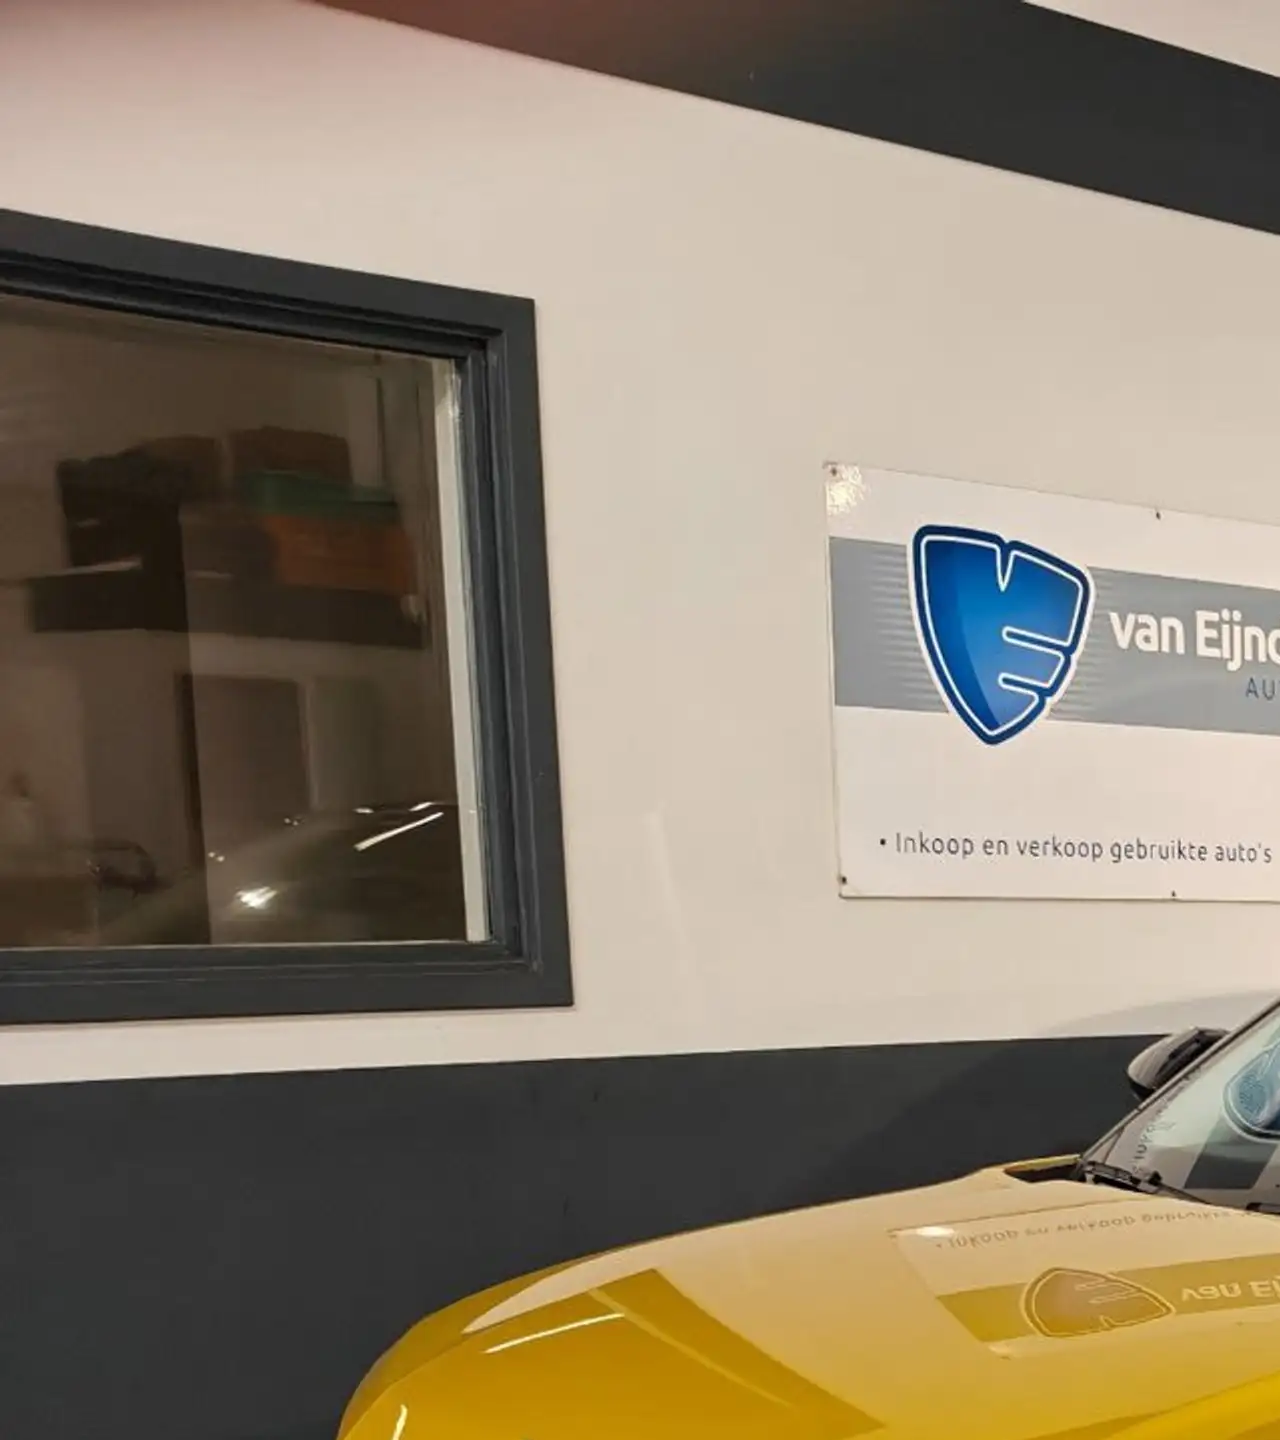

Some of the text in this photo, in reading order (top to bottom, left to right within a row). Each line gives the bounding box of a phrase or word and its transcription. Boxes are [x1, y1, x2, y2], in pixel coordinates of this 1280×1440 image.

[1108, 611, 1186, 655] van
[895, 831, 974, 859] Inkoop
[982, 838, 1009, 856] en
[1016, 834, 1104, 863] verkoop
[1110, 838, 1208, 863] gebruikte
[1215, 843, 1272, 864] auto's
